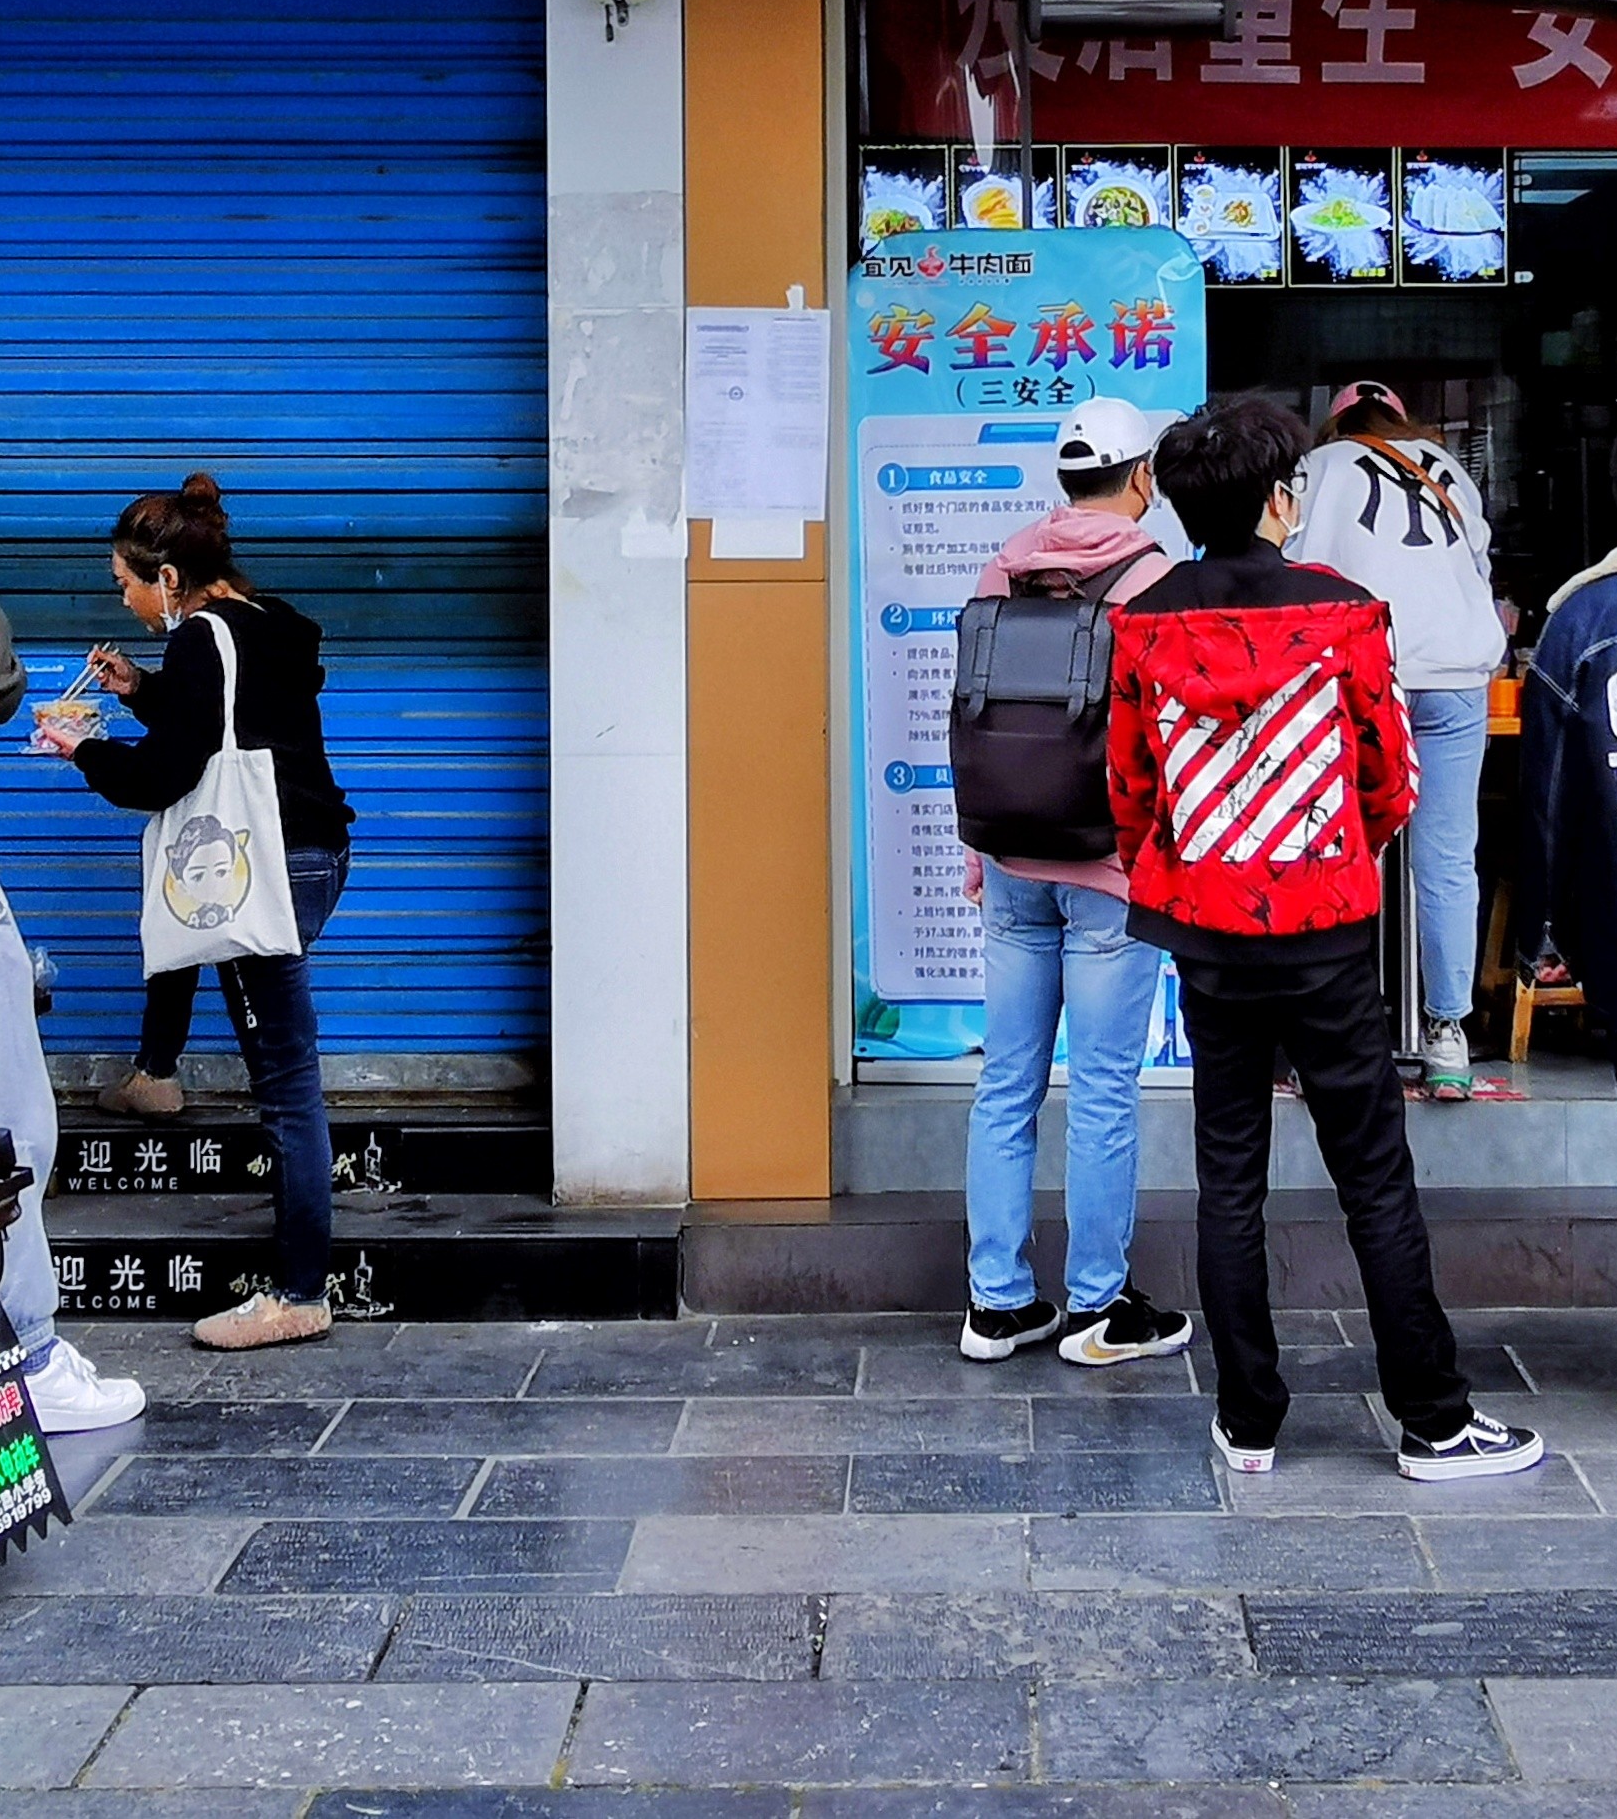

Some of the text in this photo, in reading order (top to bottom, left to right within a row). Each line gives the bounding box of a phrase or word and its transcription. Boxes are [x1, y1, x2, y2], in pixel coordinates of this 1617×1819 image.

[867, 298, 1177, 376] 安全承诺
[929, 469, 988, 486] 食品安全
[893, 765, 906, 785] 3
[78, 1137, 224, 1174] 迎光临
[68, 1177, 179, 1190] WELCOME
